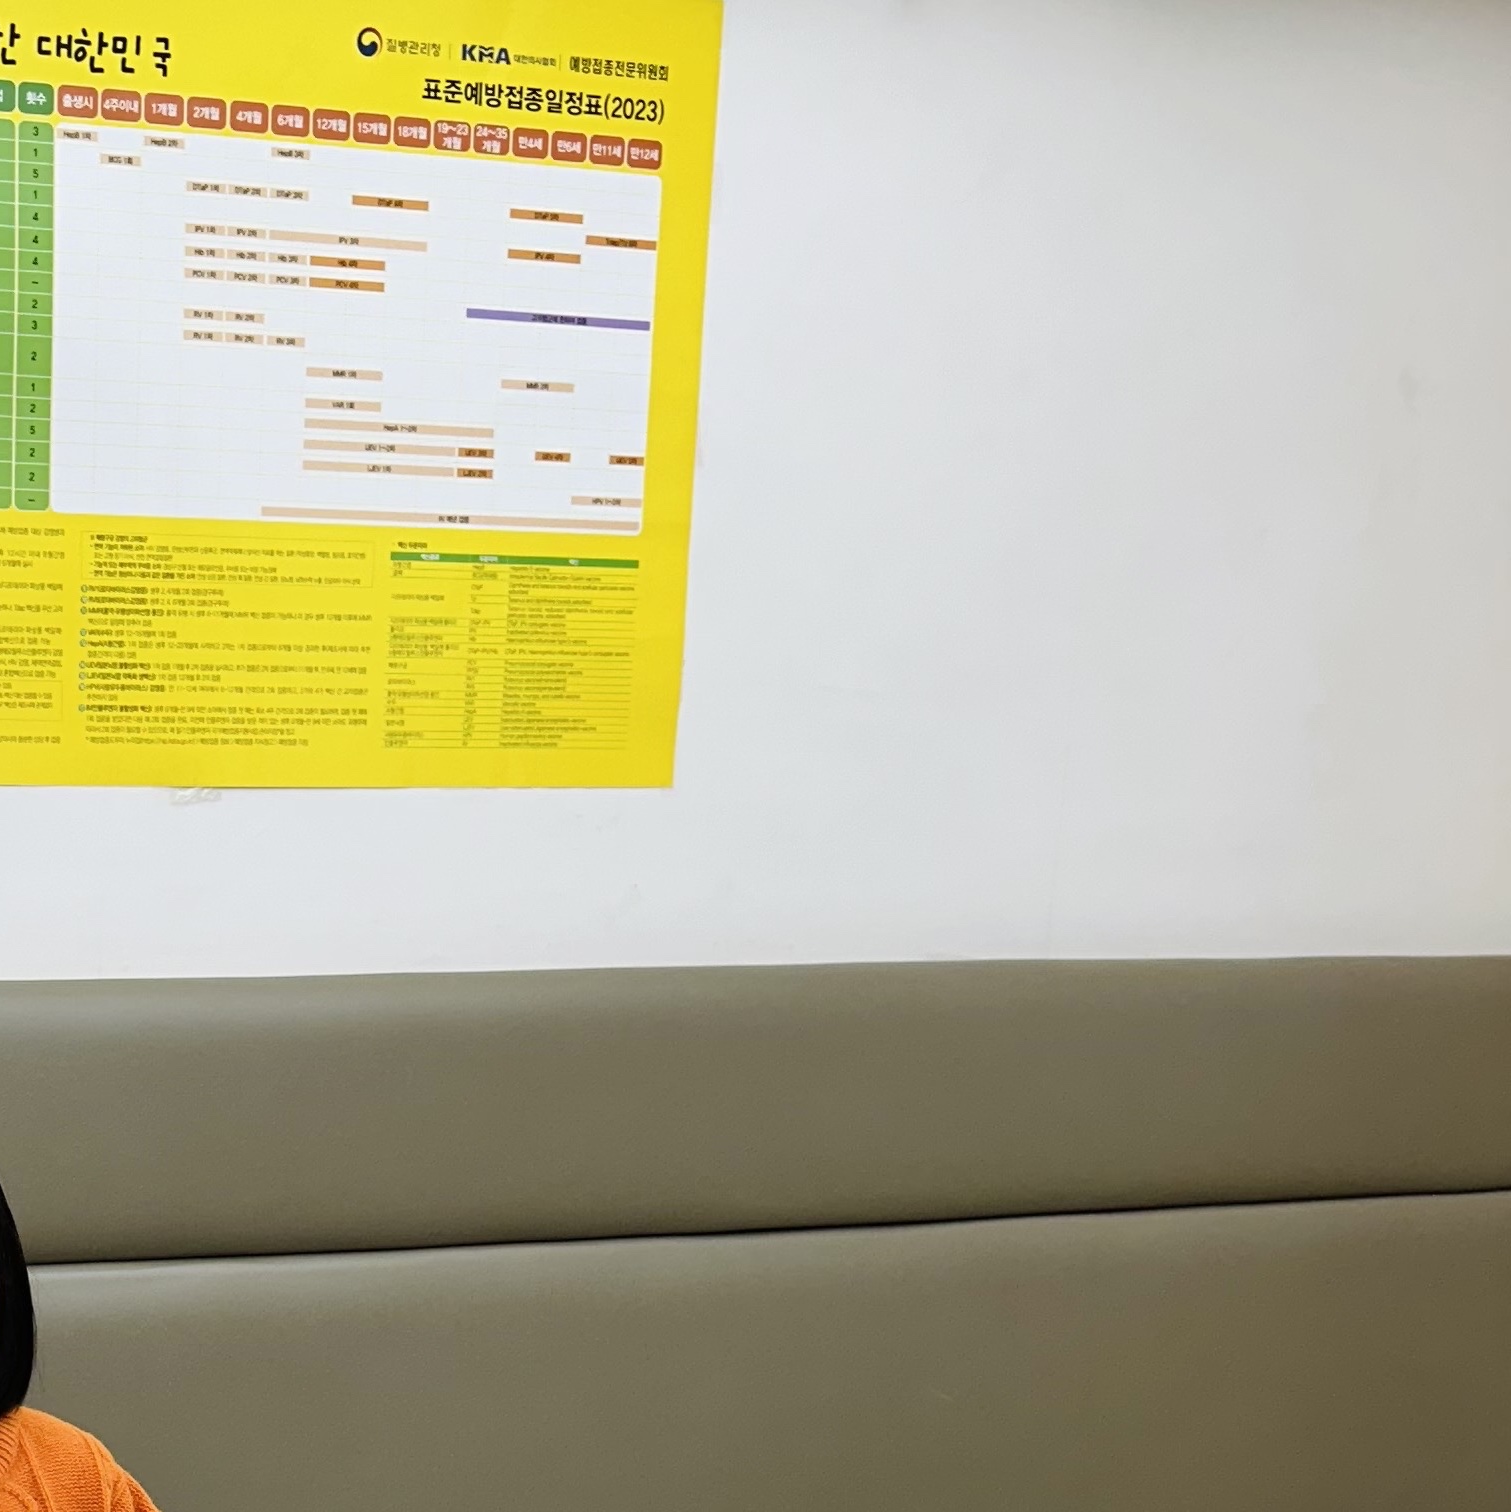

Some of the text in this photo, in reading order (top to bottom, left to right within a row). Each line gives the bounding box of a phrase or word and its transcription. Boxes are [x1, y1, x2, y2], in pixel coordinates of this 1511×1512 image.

[37, 27, 172, 77] 대한민국
[385, 37, 442, 57] 질병관리청
[461, 43, 511, 65] KMA
[569, 55, 669, 82] 예방접종전문위원회
[62, 93, 94, 110] 출생시
[103, 96, 139, 114] 4주이내
[152, 102, 178, 117] 1개월
[422, 77, 666, 126] 표준예방접종일정표(2023)
[193, 105, 220, 121] 2개월
[236, 110, 263, 125] 4개월
[277, 113, 304, 129] 6개월
[316, 117, 347, 133] 12개월
[357, 121, 388, 137] 15개월
[397, 125, 428, 141] 18개월
[442, 136, 462, 150] 개월
[482, 140, 501, 154] 개월
[518, 135, 543, 151] 만4세
[592, 142, 622, 158] 만11세
[629, 146, 659, 162] 만12세
